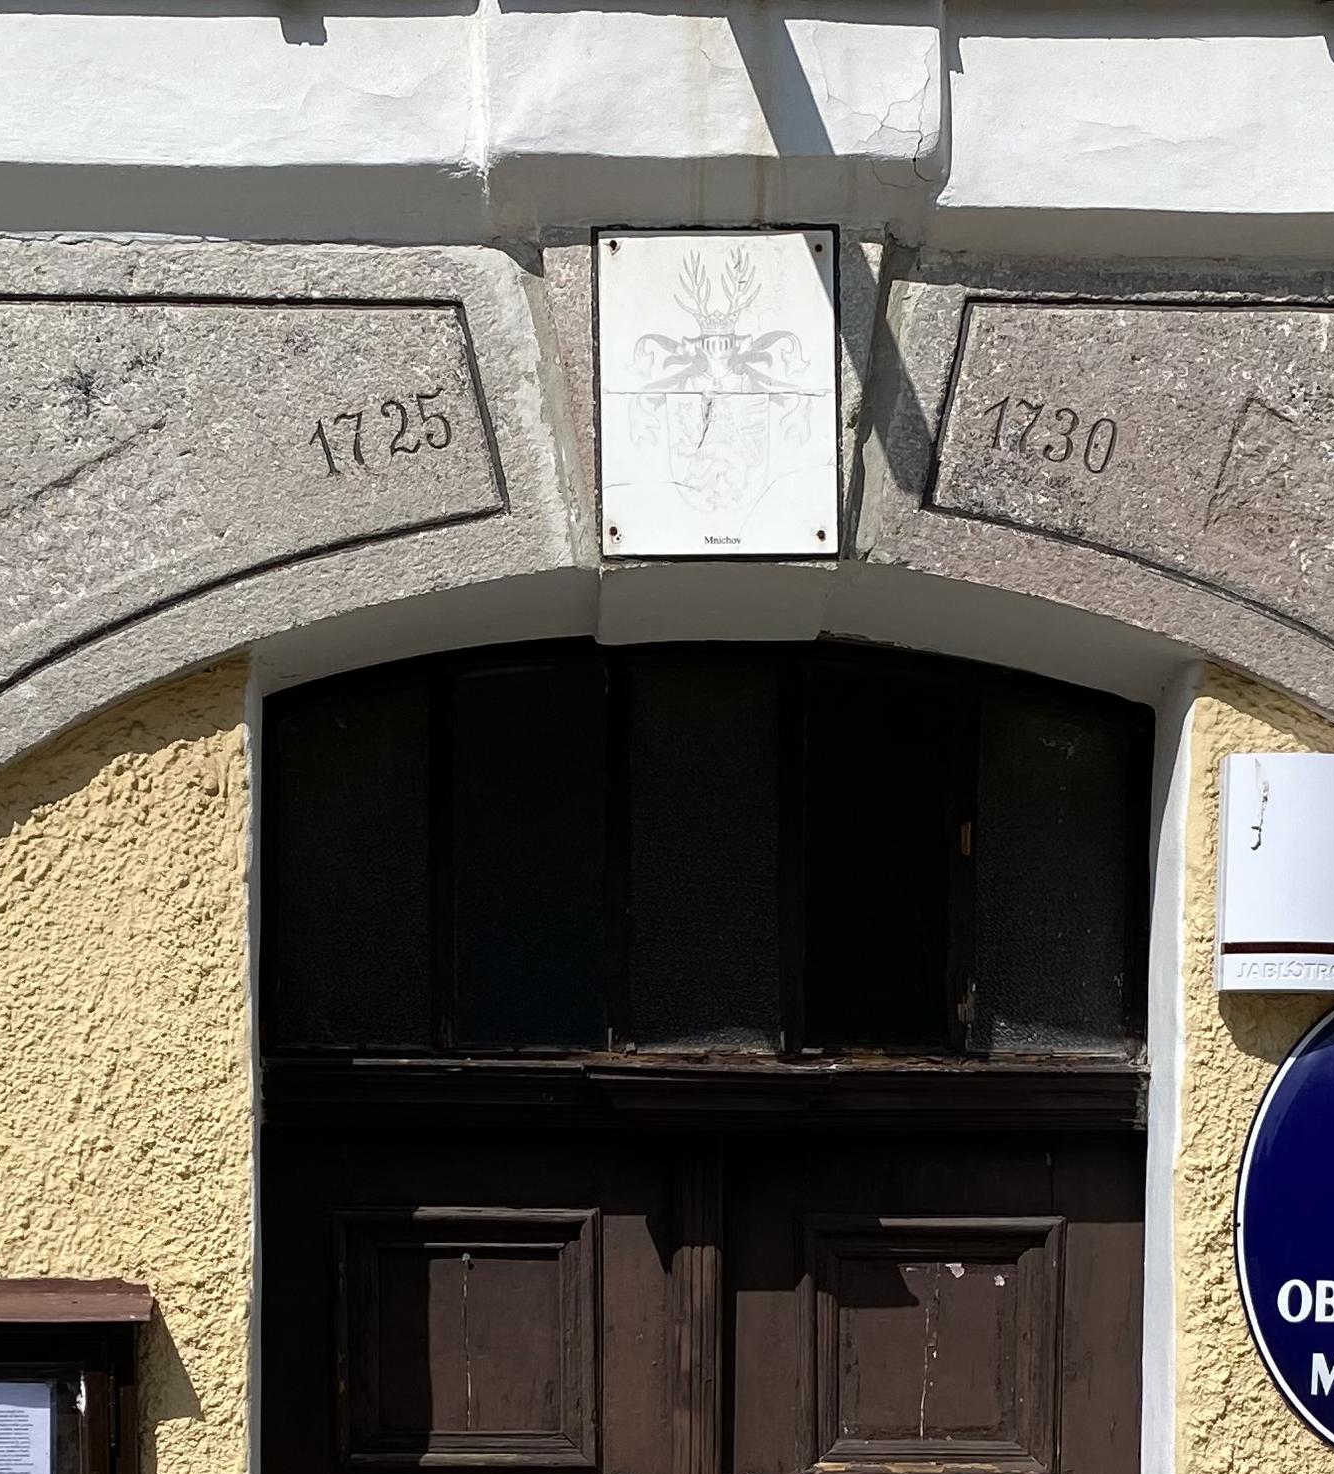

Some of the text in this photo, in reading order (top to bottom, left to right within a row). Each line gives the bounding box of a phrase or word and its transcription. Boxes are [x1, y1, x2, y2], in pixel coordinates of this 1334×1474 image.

[308, 387, 453, 476] 1725
[983, 395, 1117, 474] 1730
[703, 535, 742, 545] Mnichov
